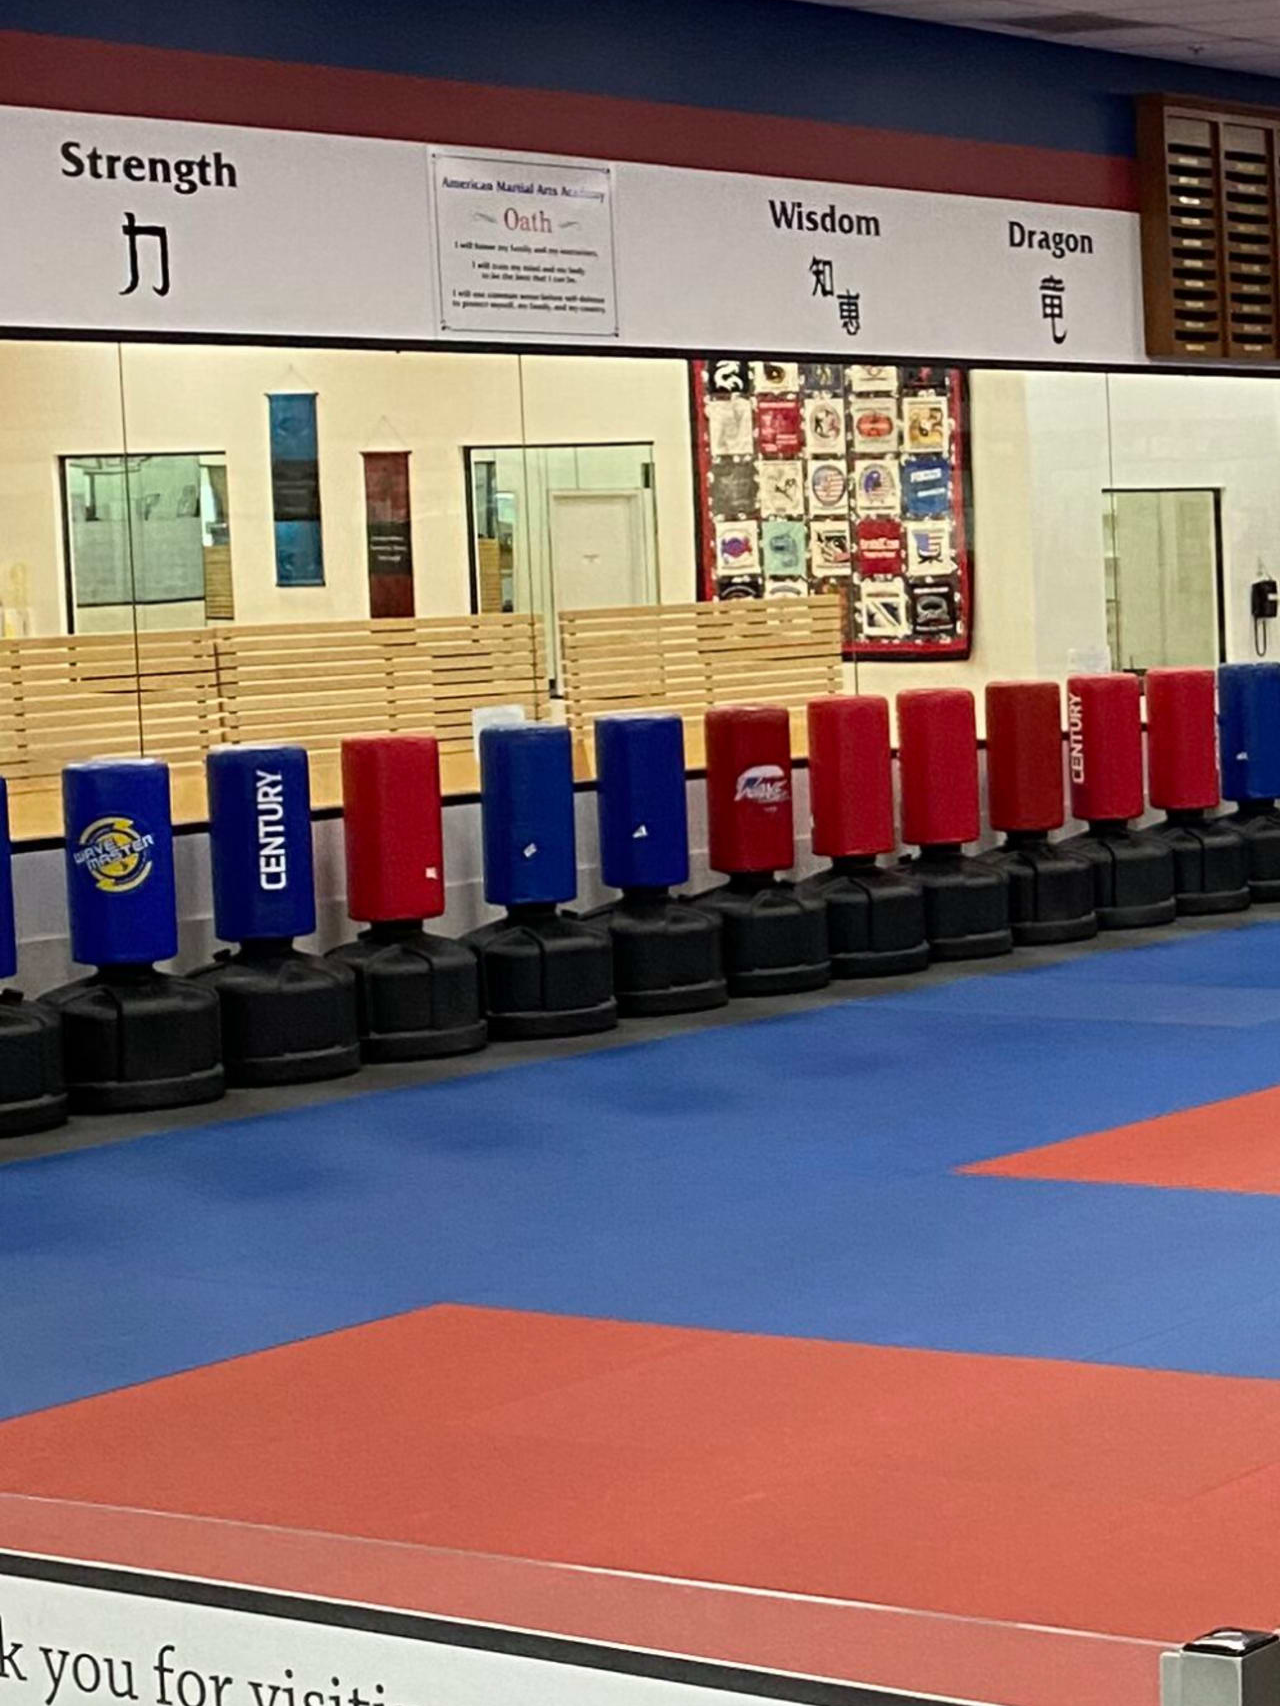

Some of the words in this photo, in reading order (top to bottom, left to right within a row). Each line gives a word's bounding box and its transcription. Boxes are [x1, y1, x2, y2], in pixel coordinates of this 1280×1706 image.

[61, 142, 236, 194] Strength
[442, 177, 493, 191] American
[496, 181, 534, 194] Martial
[537, 184, 558, 196] Arts
[504, 207, 552, 233] Oath
[769, 200, 880, 236] Wisdom
[1009, 221, 1092, 258] Dragon
[1069, 693, 1084, 784] CENTURY
[257, 771, 286, 889] CENTURY
[86, 834, 154, 871] MASTER
[39, 1647, 138, 1705] you
